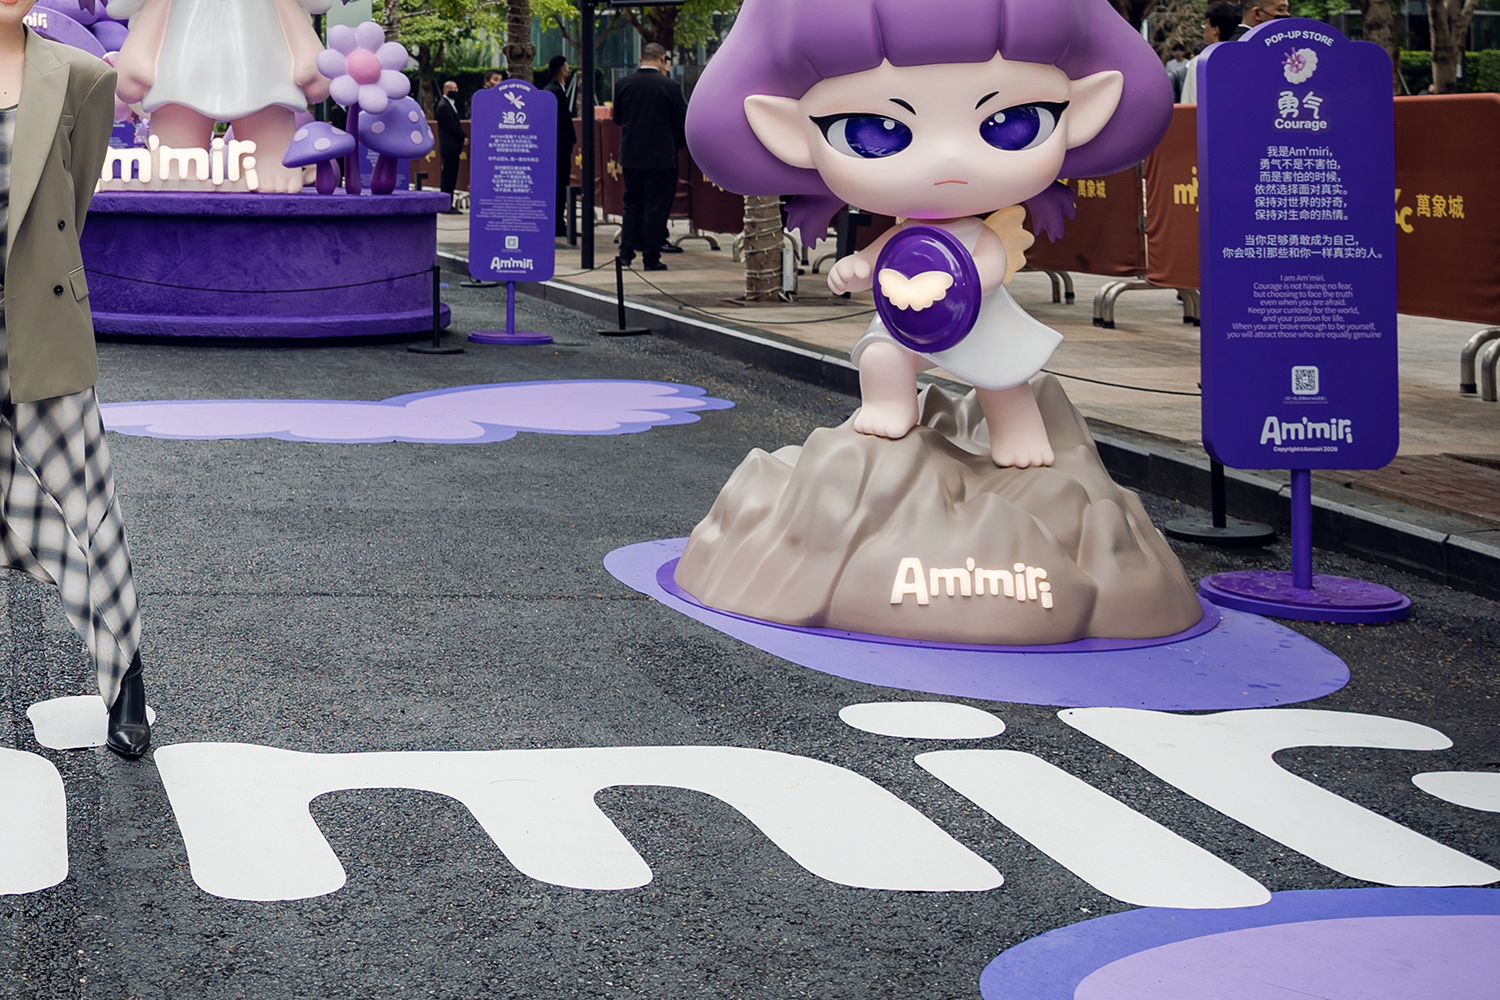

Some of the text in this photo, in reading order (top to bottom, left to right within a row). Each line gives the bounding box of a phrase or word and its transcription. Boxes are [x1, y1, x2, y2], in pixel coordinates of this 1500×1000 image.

[1264, 30, 1334, 47] POP-UP STORE
[1277, 91, 1323, 119] 勇气
[1274, 118, 1327, 132] Courage
[94, 134, 260, 193] m'miri
[1259, 158, 1341, 170] 勇气不是不害怕，
[1259, 171, 1342, 183] 而是害怕的时候，
[1254, 184, 1348, 195] 依然选择面对真实。
[1254, 196, 1348, 208] 保持对世界的好奇，
[1415, 193, 1465, 219] 萬象城
[1254, 208, 1349, 220] 保持对生命的热情。
[1244, 234, 1359, 247] 当你足够勇敢成为自己，
[1222, 247, 1383, 259] 你会吸引那些和你一样真实的人。
[490, 256, 534, 271] Am'miri
[1296, 274, 1326, 282] Am'miri.
[1253, 282, 1282, 291] Courage
[1283, 282, 1289, 290] is
[1303, 282, 1327, 291] having
[1337, 281, 1353, 291] fear,
[1253, 290, 1266, 298] but
[1266, 290, 1299, 299] choosing
[1307, 290, 1322, 298] face
[1322, 290, 1334, 298] the
[1335, 290, 1353, 298] truth
[1278, 298, 1297, 306] when
[1324, 298, 1347, 306] afraid.
[1247, 307, 1266, 315] Keep
[1283, 306, 1313, 316] curiosity
[1313, 306, 1324, 314] for
[1337, 306, 1360, 315] world,
[1293, 315, 1320, 323] passion
[1321, 314, 1331, 322] for
[1332, 314, 1345, 322] life.
[1231, 322, 1253, 330] When
[1280, 322, 1300, 330] brave
[1300, 323, 1327, 331] enough
[1346, 322, 1376, 331] yourself,
[1226, 332, 1240, 340] you
[1240, 330, 1253, 338] will
[1326, 330, 1352, 340] equally
[1353, 331, 1382, 340] genuine
[1260, 416, 1353, 445] Am'miri
[890, 557, 1053, 609] Am'miri
